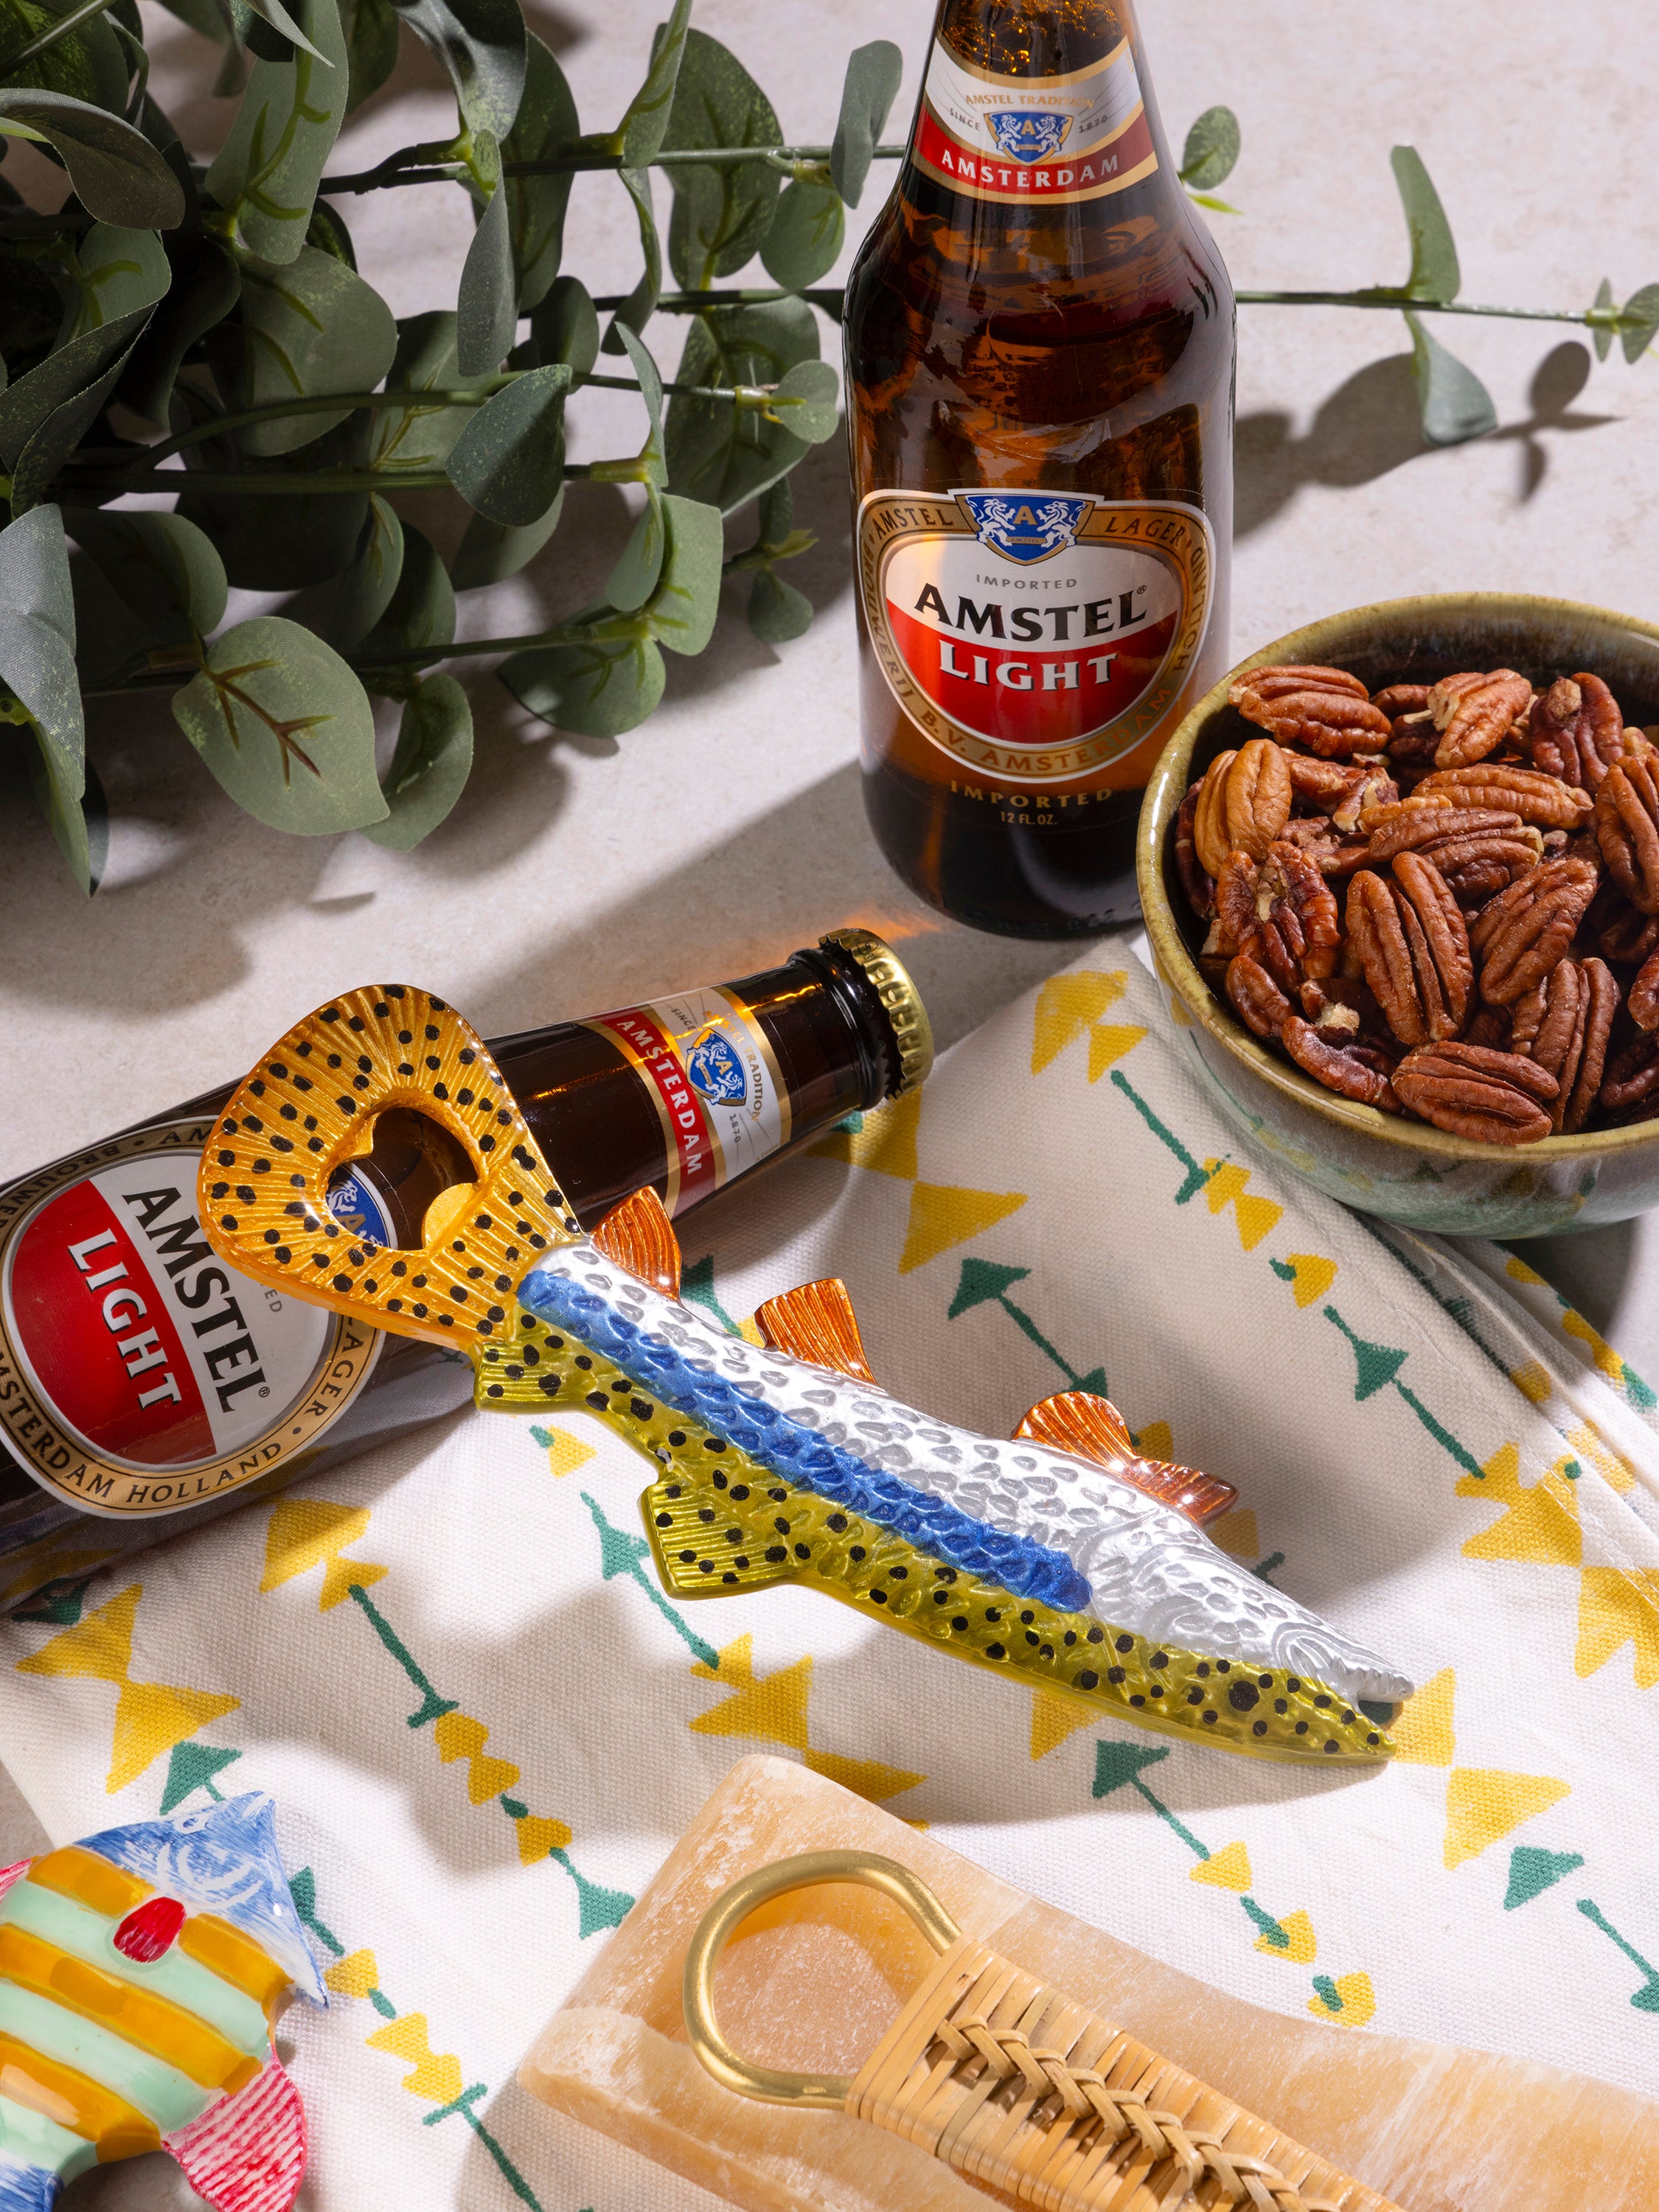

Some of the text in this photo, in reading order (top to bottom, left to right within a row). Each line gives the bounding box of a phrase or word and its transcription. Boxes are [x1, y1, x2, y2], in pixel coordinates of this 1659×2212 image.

[966, 94, 1095, 108] AMSTEL TRADITION
[949, 107, 981, 131] SINCE
[1020, 119, 1036, 135] A
[1078, 115, 1108, 133] 1870
[941, 149, 1119, 187] AMSTERDAM
[872, 508, 953, 540] AMSTEL
[1012, 505, 1038, 525] A
[1105, 517, 1186, 547] LAGER
[976, 574, 1077, 590] IMPORTED
[1171, 546, 1207, 671] HOLLAND
[939, 639, 1119, 692] LIGHT
[980, 685, 1172, 771] AMSTERDAM
[951, 779, 1112, 808] IMPORTED
[1001, 812, 1015, 824] 12
[671, 1008, 697, 1031] SINCE
[715, 1061, 733, 1076] A
[616, 1020, 702, 1175] AMSTERDAM
[744, 1046, 764, 1122] TRADITION
[729, 1113, 742, 1143] 1870
[67, 1228, 183, 1411] LIGHT
[304, 1318, 364, 1416] AGER
[126, 1443, 281, 1503] HOLLAND
